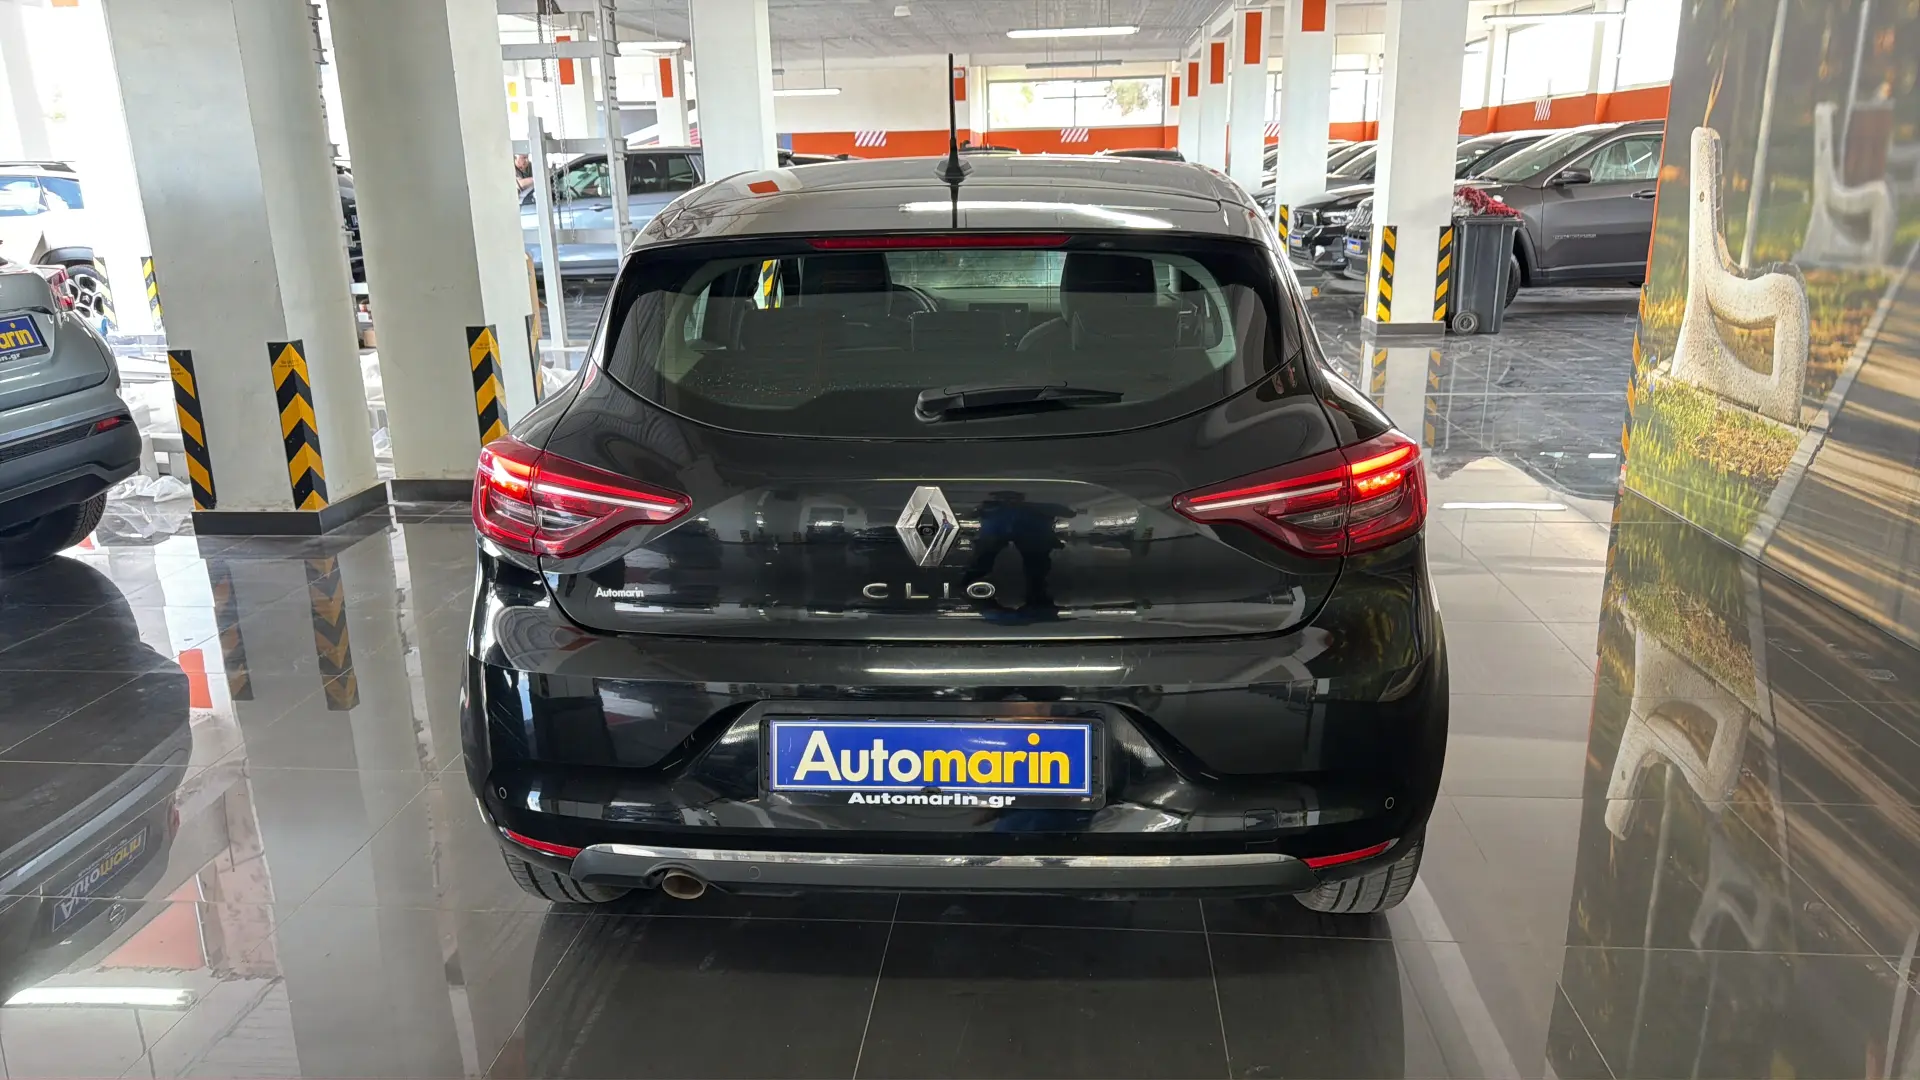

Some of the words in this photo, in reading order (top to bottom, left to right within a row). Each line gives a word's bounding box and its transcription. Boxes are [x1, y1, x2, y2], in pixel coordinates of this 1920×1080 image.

[594, 586, 645, 598] Automarin
[862, 581, 996, 599] CLIO
[793, 730, 1070, 784] Automarin
[848, 791, 1016, 808] Automarin.gr
